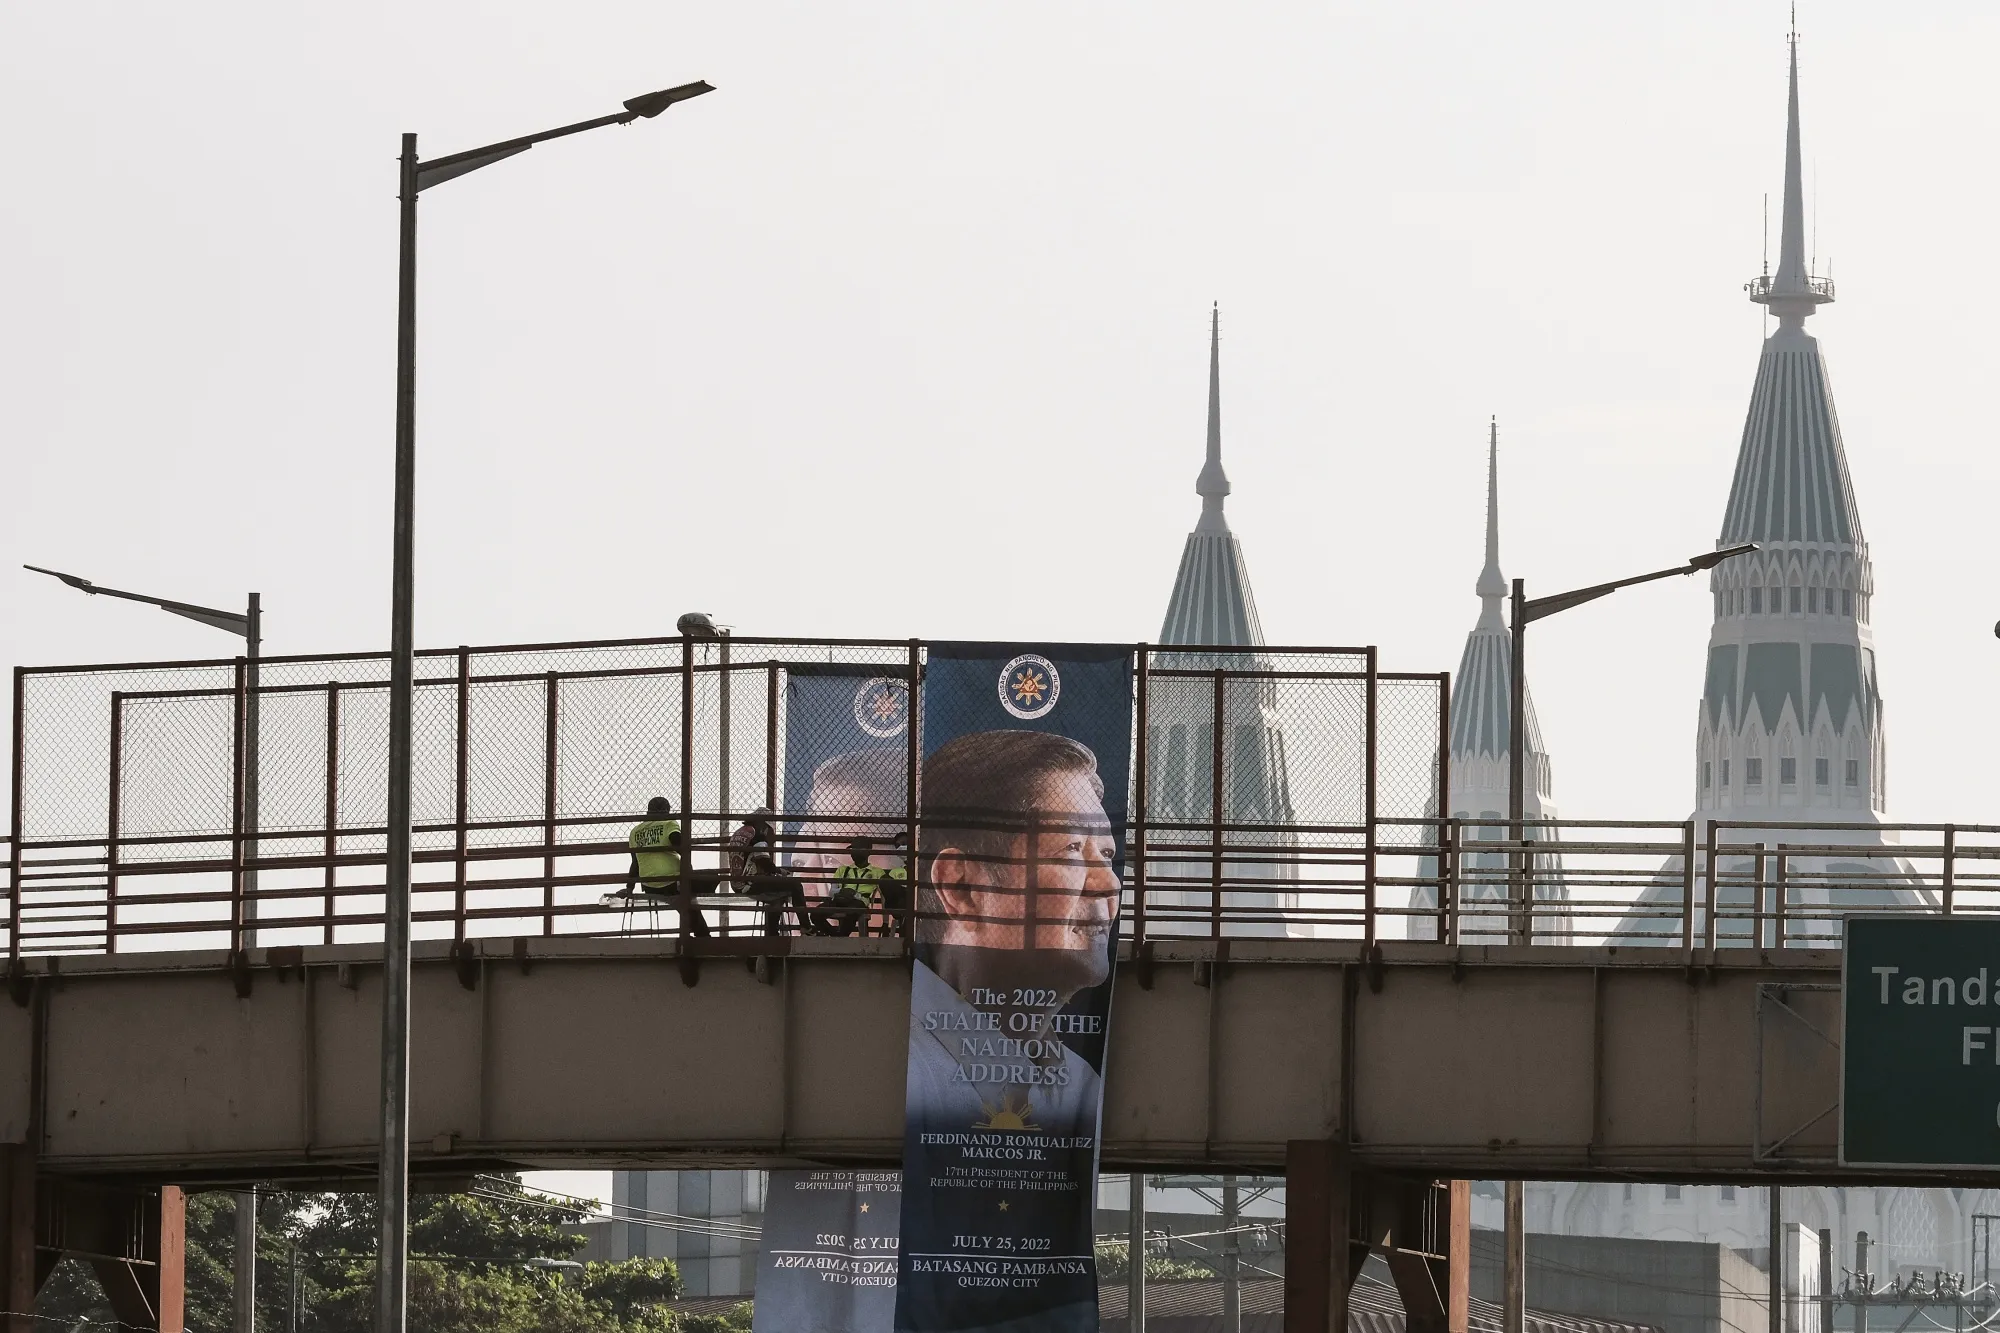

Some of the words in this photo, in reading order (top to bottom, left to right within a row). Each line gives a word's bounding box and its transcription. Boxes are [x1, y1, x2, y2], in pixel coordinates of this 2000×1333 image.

[1015, 655, 1044, 664] PANGULO
[1872, 966, 2000, 1006] Tand
[971, 988, 1007, 1005] The
[1011, 988, 1057, 1007] 2022
[925, 1011, 1002, 1032] STATE
[1008, 1012, 1045, 1032] OF
[1050, 1014, 1102, 1034] THE
[960, 1037, 1064, 1059] NATION
[952, 1063, 1071, 1086] ADDRESS
[920, 1133, 1002, 1146] FERDINAND
[961, 1147, 1023, 1160] MARCOS
[1026, 1149, 1047, 1161] JR.
[945, 1166, 968, 1176] 17TH
[970, 1167, 1028, 1179] PRESIDENT
[1030, 1171, 1045, 1179] OF
[1047, 1171, 1068, 1180] THE
[930, 1177, 978, 1188] REPUBLIC
[979, 1179, 994, 1188] OF
[996, 1180, 1017, 1189] THE
[1019, 1180, 1079, 1191] PHILIPPINES
[952, 1235, 993, 1249] JULY
[995, 1237, 1017, 1252] 25,
[1020, 1238, 1051, 1251] 2022
[912, 1259, 998, 1274] BATASANG
[1002, 1262, 1087, 1275] PAMBANSA
[958, 1276, 1009, 1288] QUEZON
[1012, 1278, 1040, 1288] CITY
